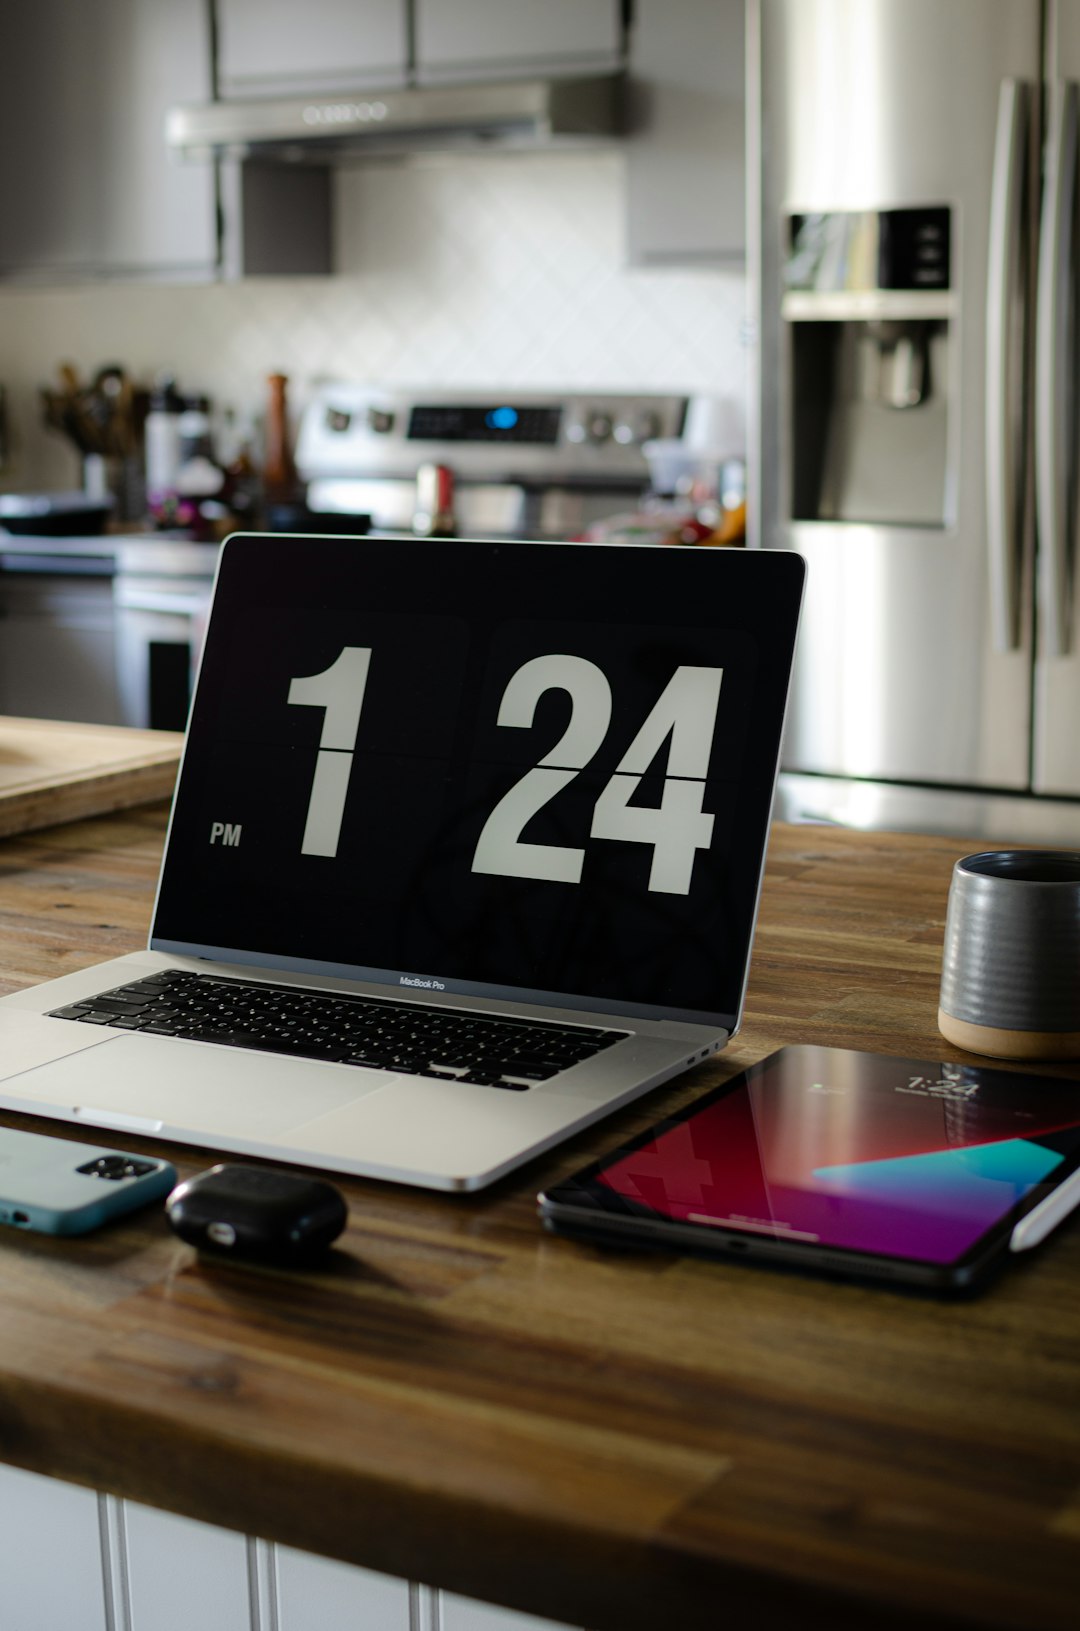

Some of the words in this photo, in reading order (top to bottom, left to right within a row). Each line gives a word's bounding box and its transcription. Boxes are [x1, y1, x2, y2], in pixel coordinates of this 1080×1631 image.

[288, 647, 371, 857] 1
[471, 655, 723, 895] 24
[210, 823, 242, 846] PM
[400, 977, 432, 988] MacBook
[432, 980, 445, 990] Pro
[908, 1076, 980, 1096] 1:24
